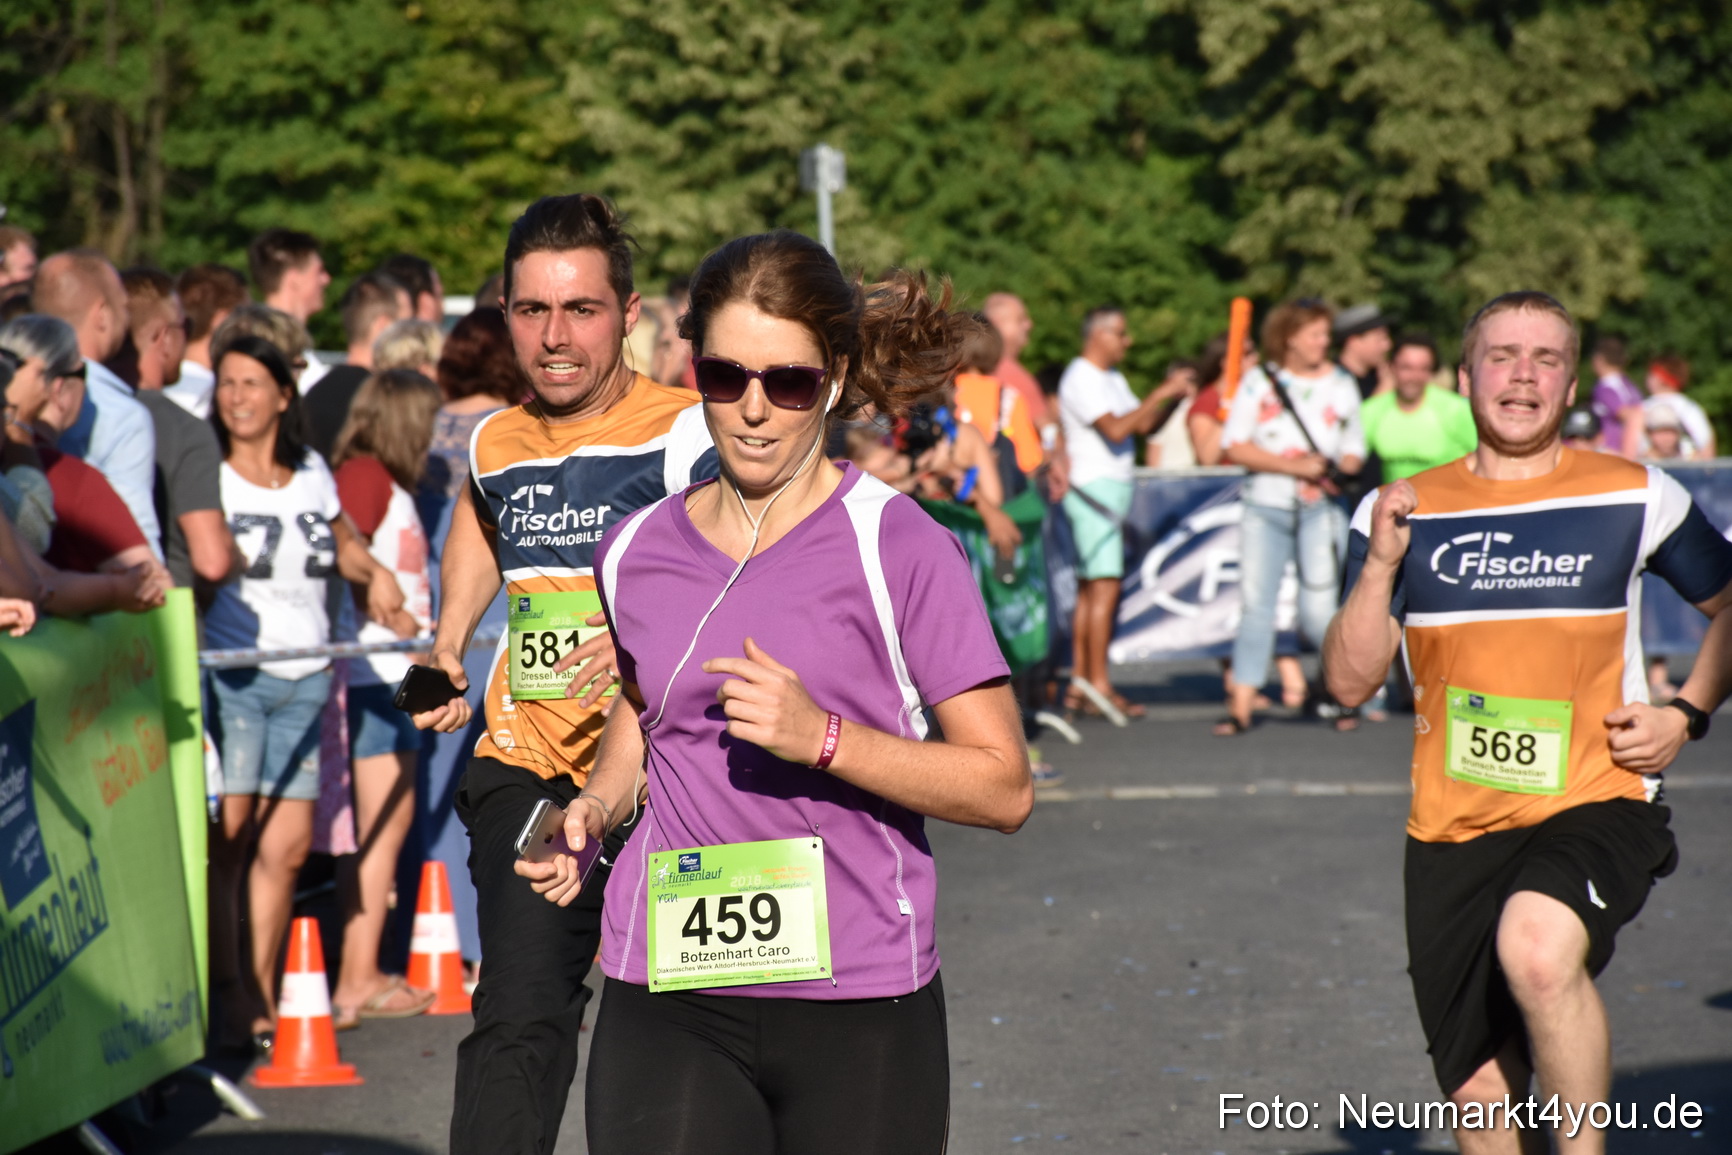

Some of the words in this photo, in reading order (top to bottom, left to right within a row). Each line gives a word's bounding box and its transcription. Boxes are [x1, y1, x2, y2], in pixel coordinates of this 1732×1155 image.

[511, 503, 612, 533] Fischer
[516, 530, 603, 547] AUTOMOBILE
[1458, 550, 1593, 576] Fischer
[1470, 576, 1582, 590] AUTOMOBILE
[520, 630, 582, 669] 581
[521, 671, 553, 681] Dressel
[555, 669, 577, 680] Fabi
[828, 715, 840, 736] 2018
[822, 737, 836, 757] YSS
[1469, 725, 1537, 766] 568
[668, 867, 723, 884] firmenlauf
[730, 875, 762, 888] 2018
[681, 892, 782, 946] 459
[681, 947, 753, 963] Botzenhart
[757, 945, 791, 958] Caro
[656, 964, 696, 974] Diakonisches
[697, 963, 713, 971] Werk
[714, 957, 804, 969] Altdorf-Hersbruck-Neumarkt
